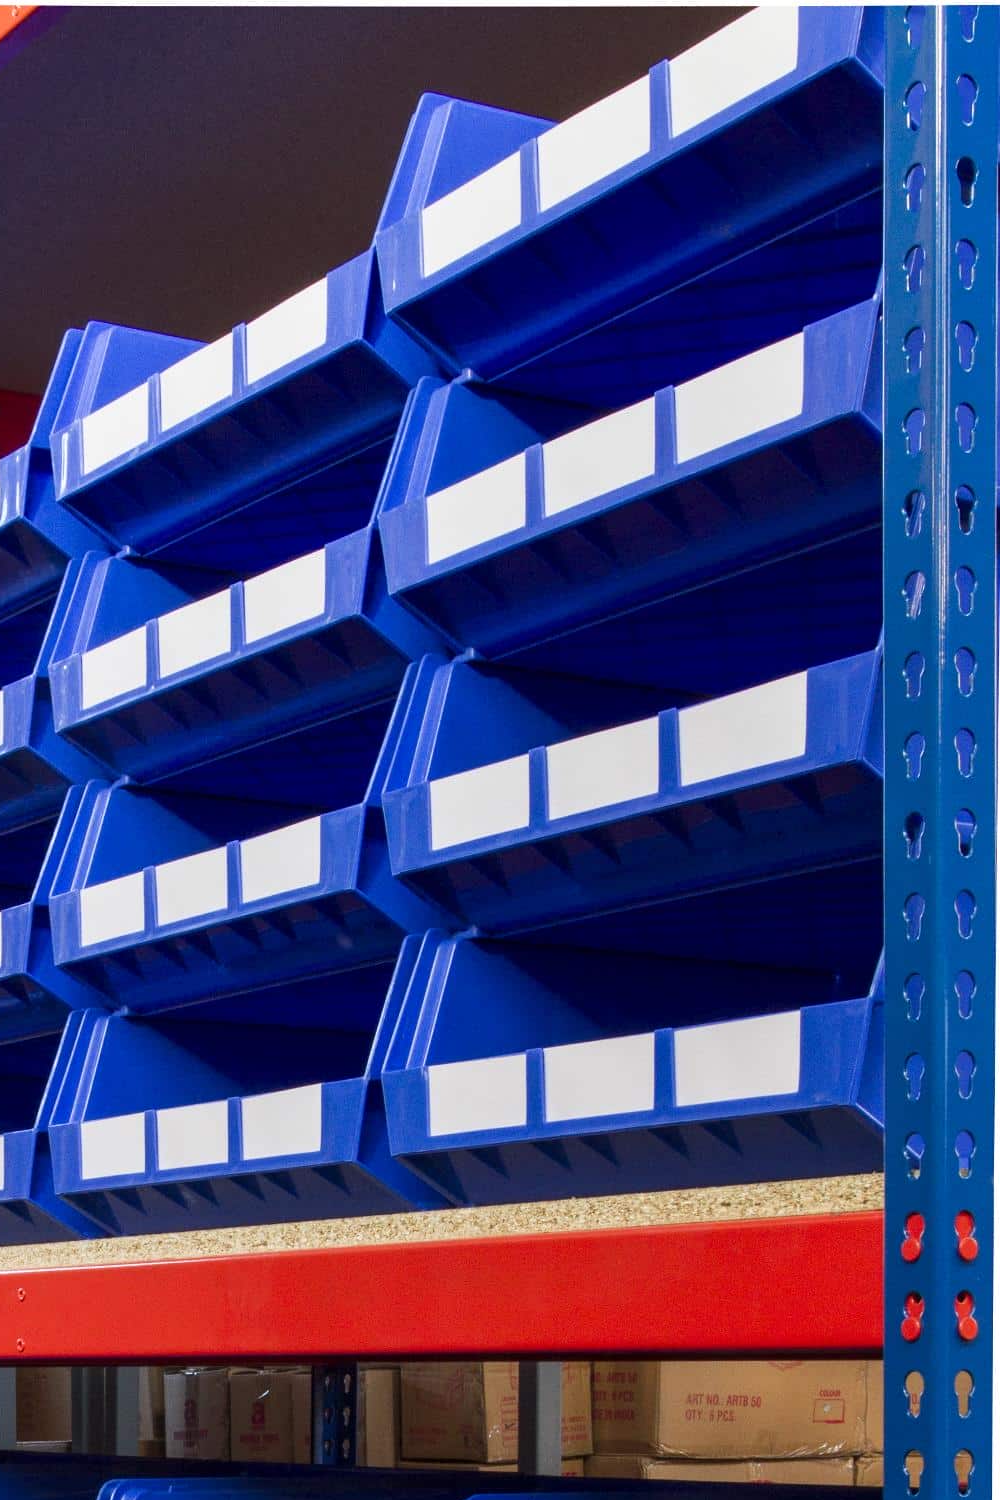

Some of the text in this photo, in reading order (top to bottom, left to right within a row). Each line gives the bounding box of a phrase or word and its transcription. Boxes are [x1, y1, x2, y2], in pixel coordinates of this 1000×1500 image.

[686, 1393, 704, 1406] ART
[726, 1394, 749, 1407] ARTB
[751, 1395, 762, 1408] 50
